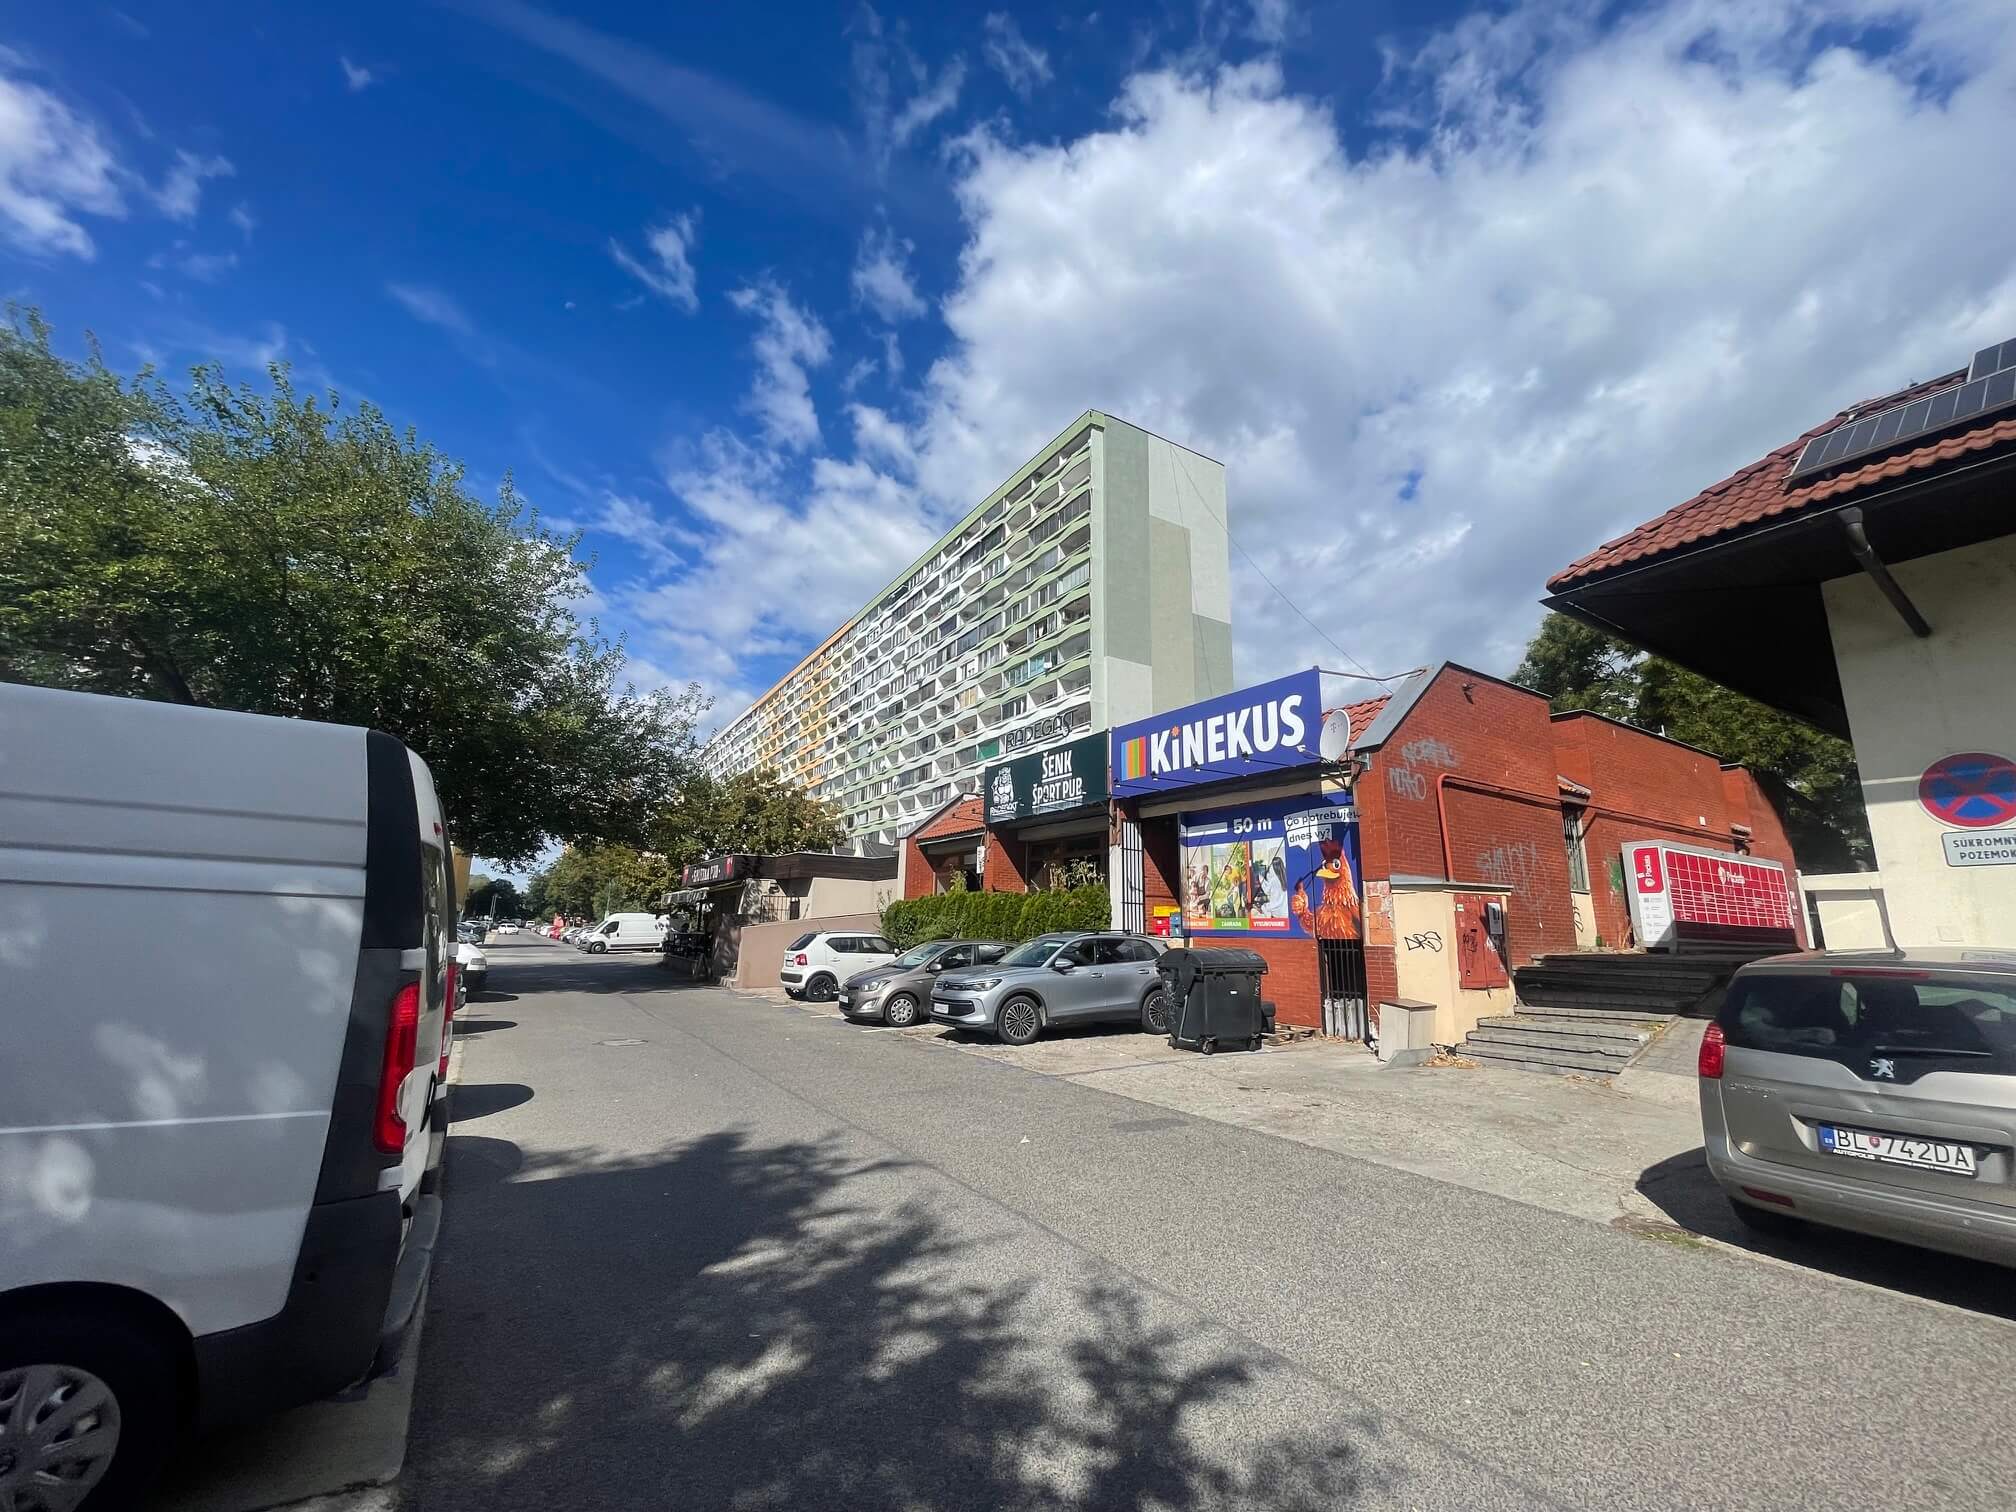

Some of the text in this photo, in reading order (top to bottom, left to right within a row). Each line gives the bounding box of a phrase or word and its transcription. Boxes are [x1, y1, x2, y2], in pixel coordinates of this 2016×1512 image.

[1041, 749, 1072, 779] ŠENK
[1032, 777, 1082, 806] ŠPORT PUB
[1233, 816, 1272, 834] 50 m
[1289, 827, 1331, 843] dnes vy?
